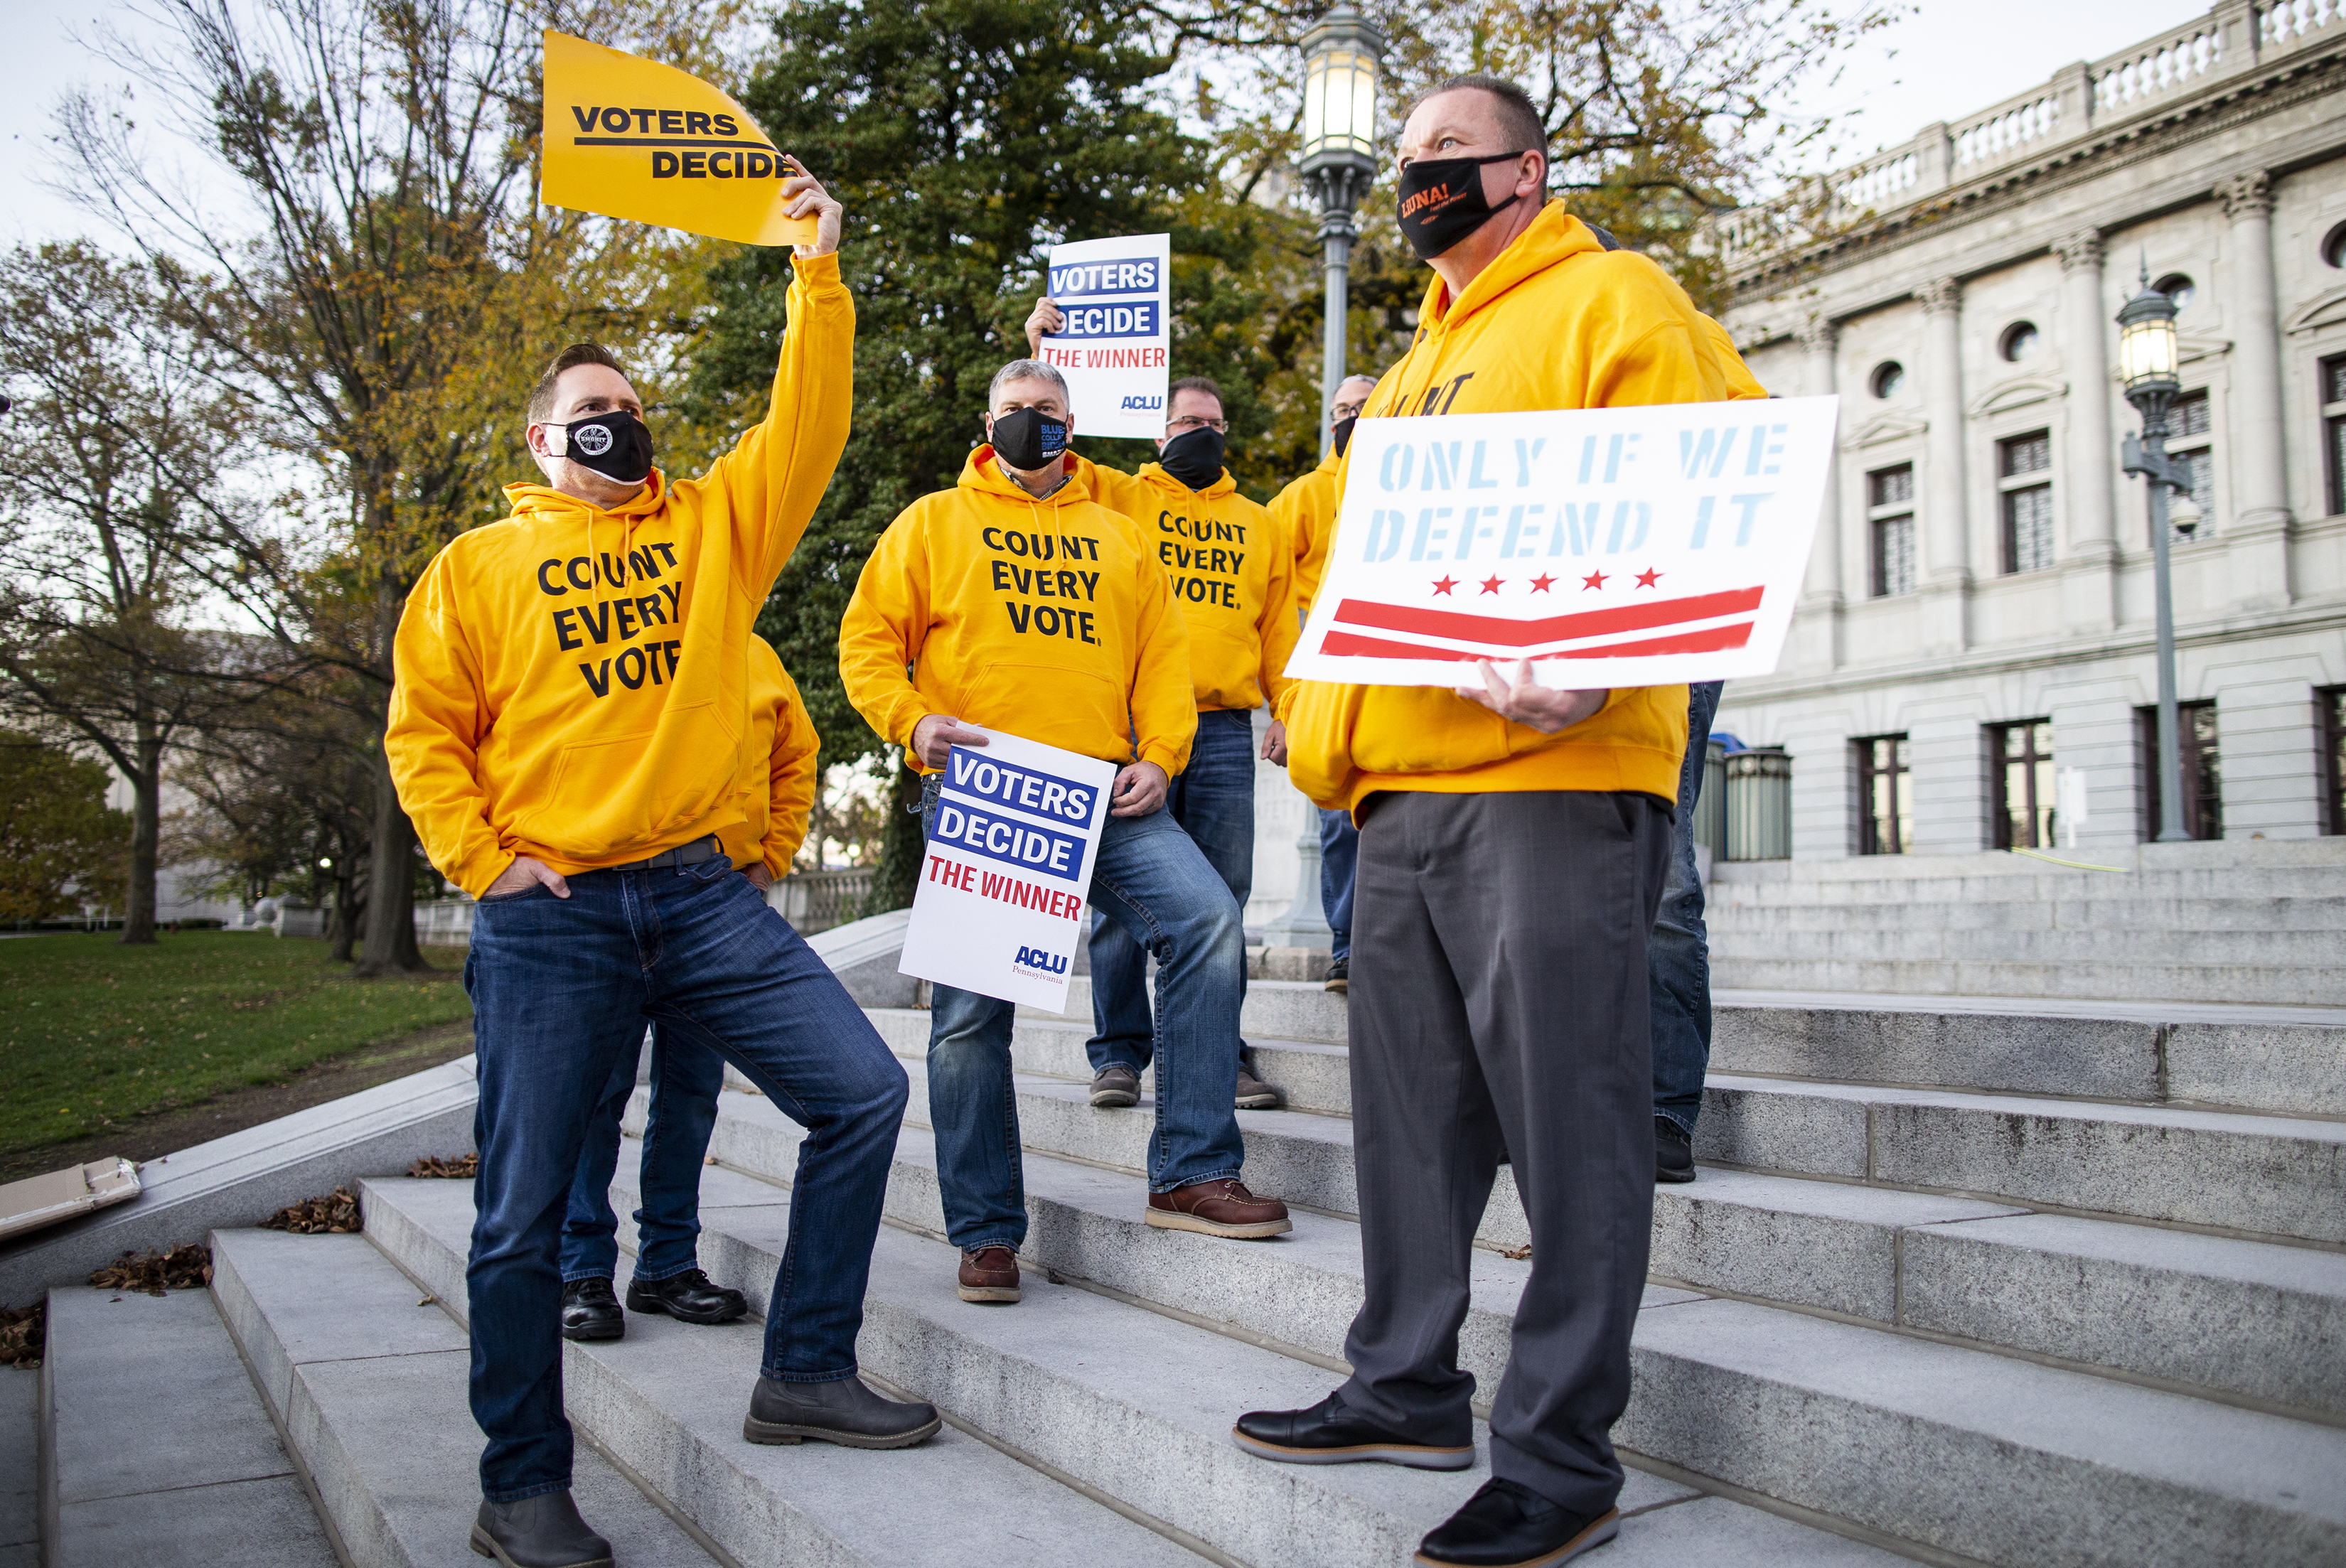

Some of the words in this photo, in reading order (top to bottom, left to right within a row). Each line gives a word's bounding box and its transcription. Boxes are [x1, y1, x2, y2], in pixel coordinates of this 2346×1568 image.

[571, 106, 739, 136] VOTERS
[653, 151, 798, 178] DECIDE
[1051, 262, 1155, 294] VOTERS
[1044, 348, 1081, 367] THE
[1088, 348, 1165, 367] WINNER
[1120, 395, 1162, 409] ACLU
[1041, 424, 1065, 434] BLUE
[1378, 436, 1546, 492] ONLY
[1578, 432, 1643, 485] IF
[1679, 424, 1788, 480] WE
[1159, 510, 1246, 544] COUNT
[1362, 500, 1652, 564] DEFEND
[1689, 492, 1776, 550] IT
[982, 527, 1099, 562] COUNT
[1159, 541, 1245, 575] EVERY
[537, 542, 678, 596] COUNT
[992, 559, 1100, 602] EVERY
[552, 581, 682, 651] EVERY
[953, 753, 1091, 820] VOTERS
[937, 805, 1073, 871] DECIDE
[928, 855, 978, 893] THE
[980, 871, 1081, 922] WINNER
[1012, 965, 1063, 984] Pennsylvania
[1014, 945, 1068, 974] ACLU
